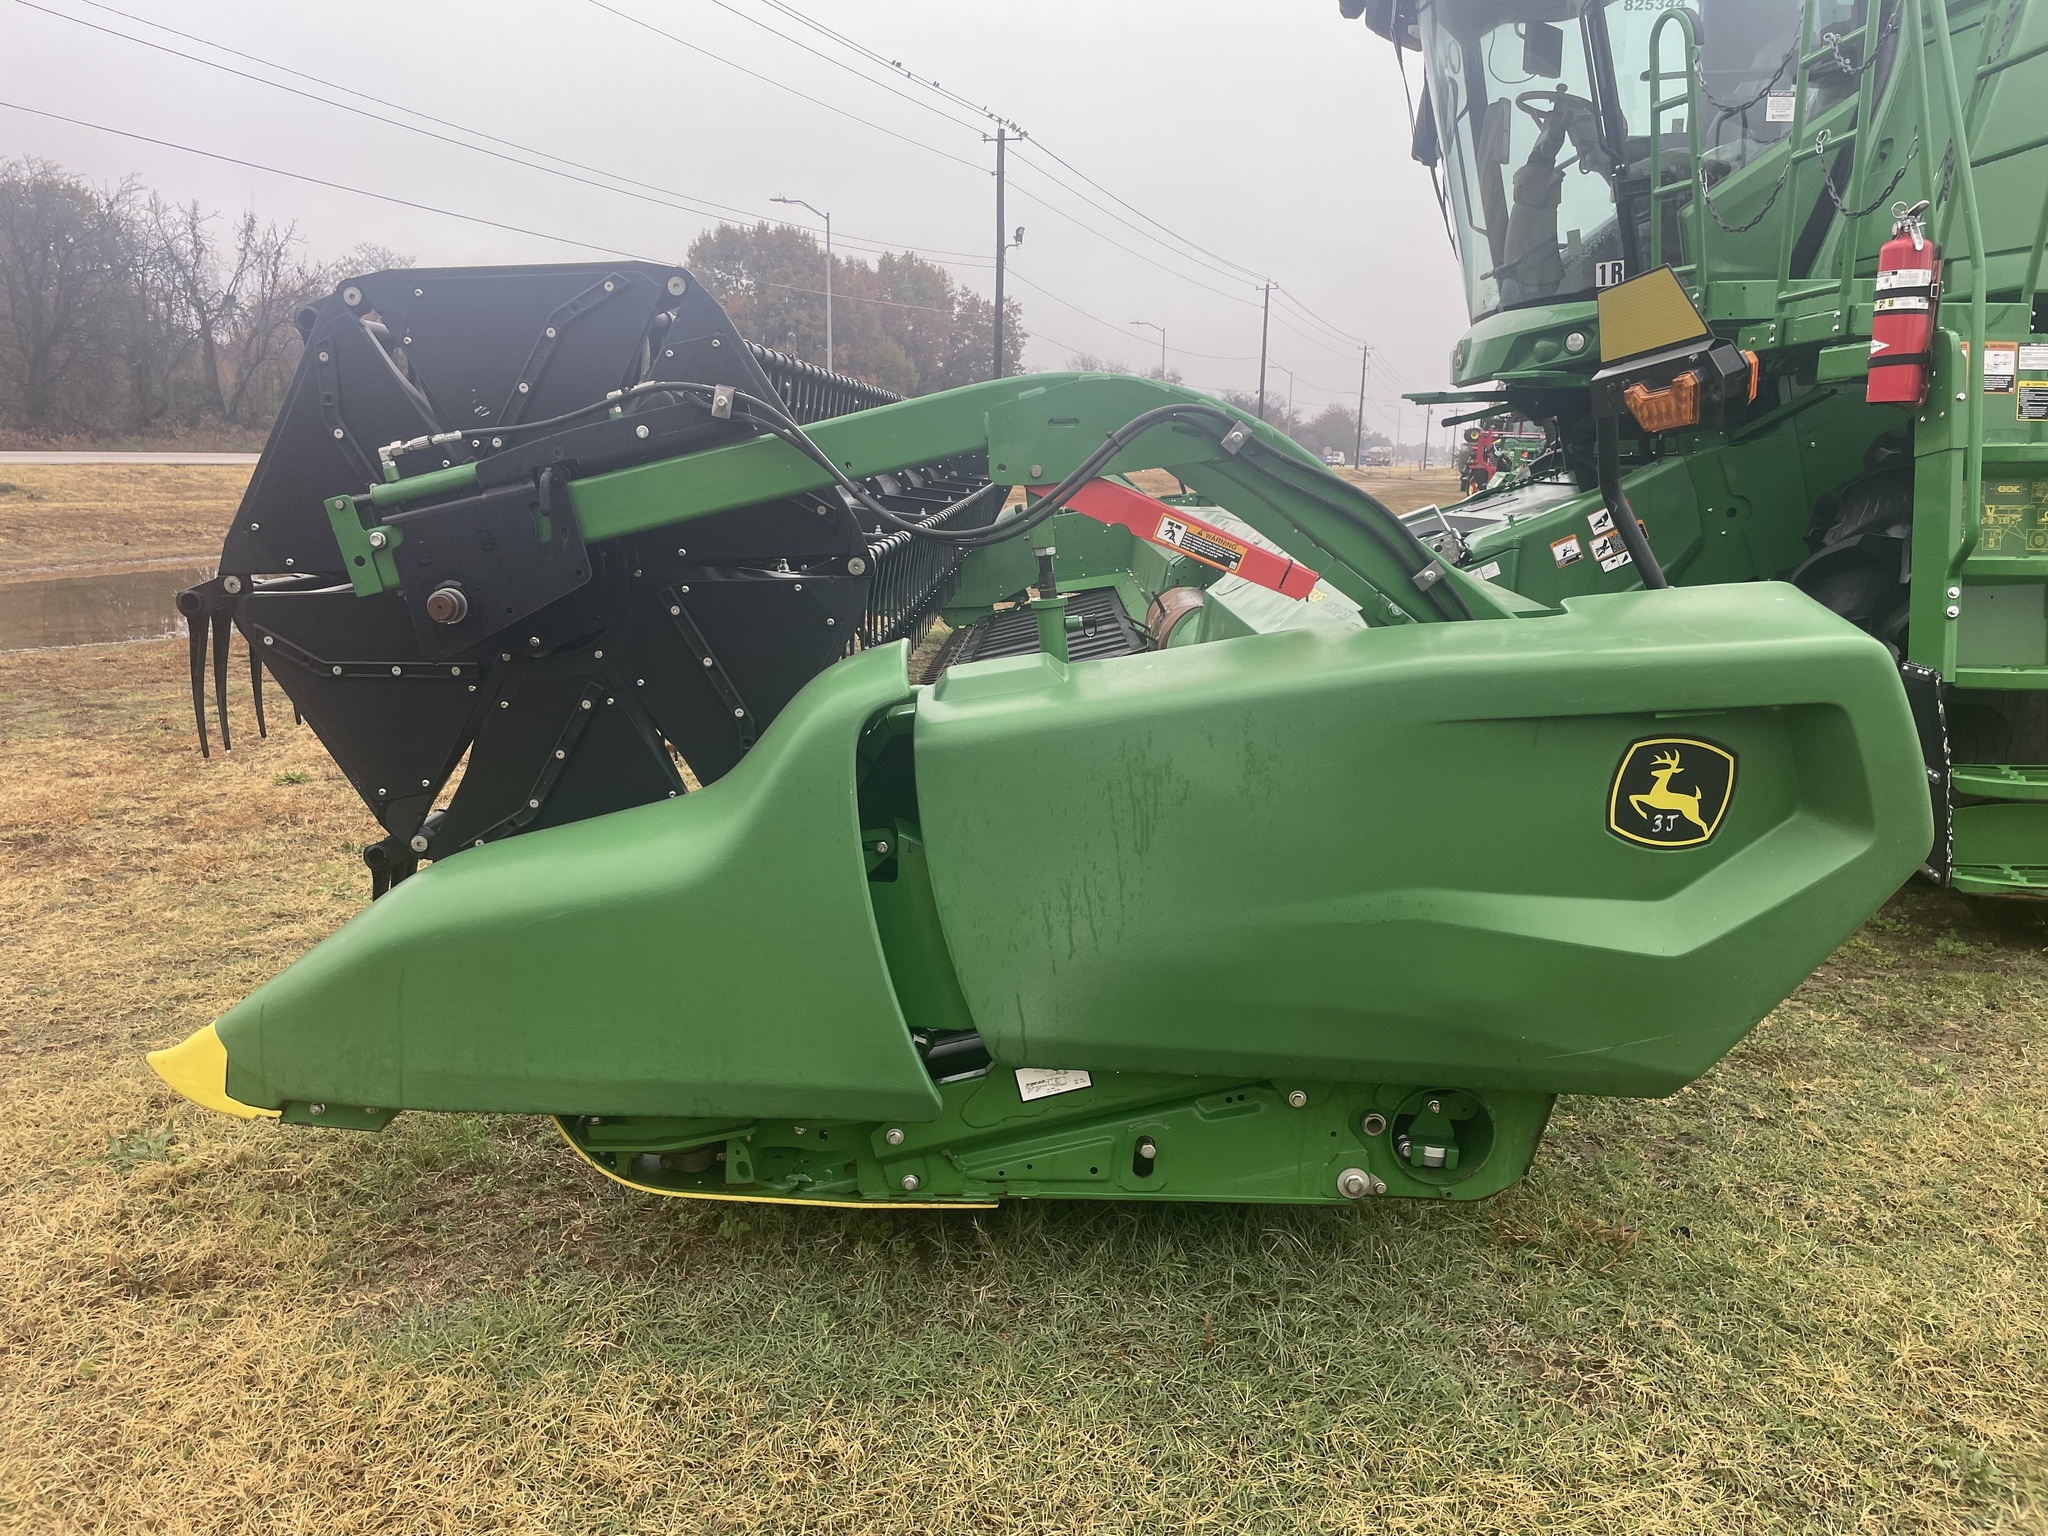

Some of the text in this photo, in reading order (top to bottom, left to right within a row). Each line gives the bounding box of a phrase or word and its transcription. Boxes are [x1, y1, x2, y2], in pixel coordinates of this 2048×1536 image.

[1624, 0, 1686, 11] 825344
[1599, 262, 1622, 286] 1R
[1205, 532, 1237, 551] WARNING
